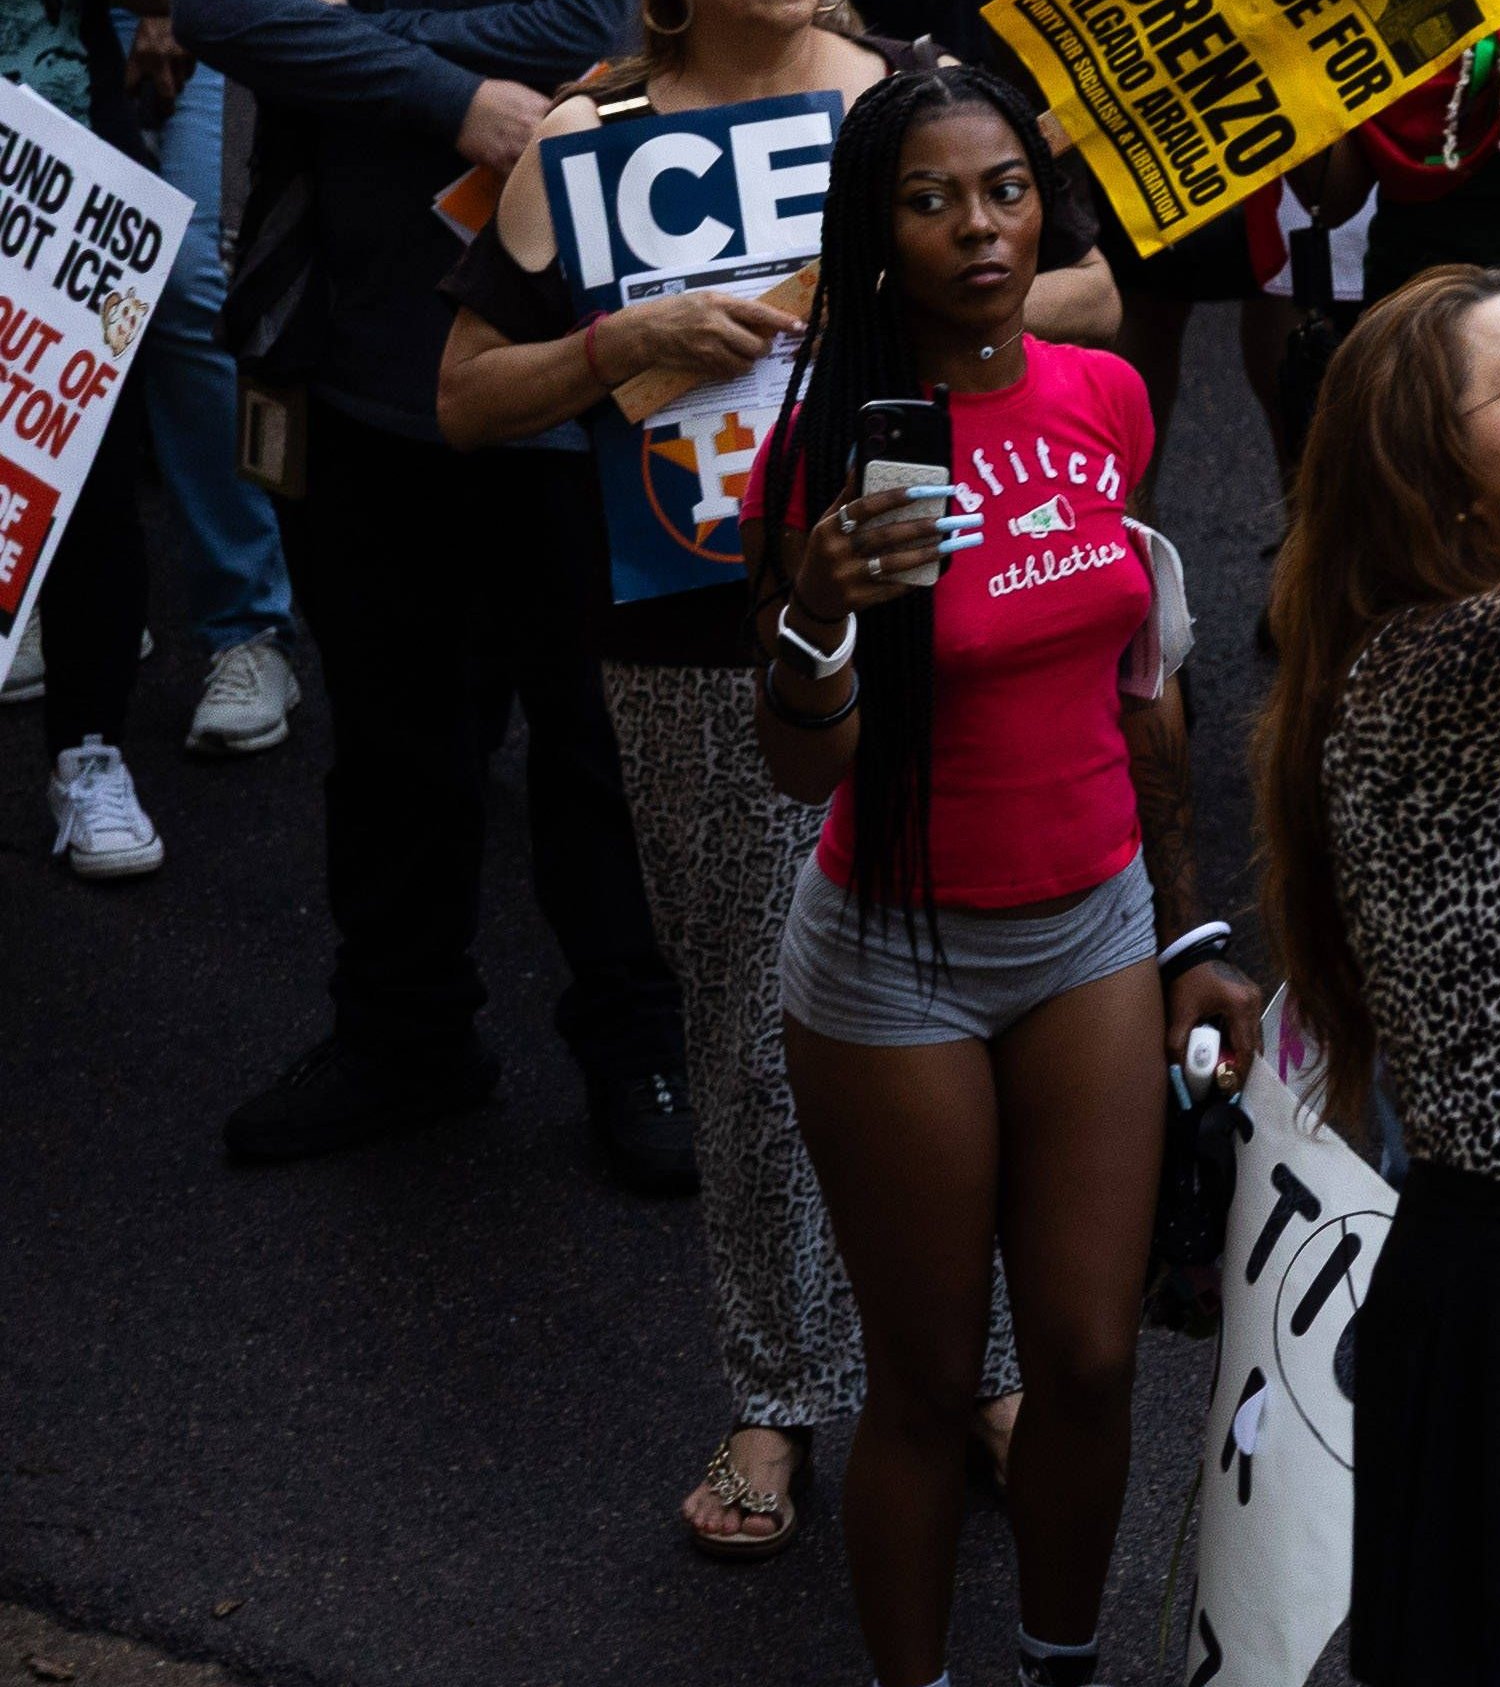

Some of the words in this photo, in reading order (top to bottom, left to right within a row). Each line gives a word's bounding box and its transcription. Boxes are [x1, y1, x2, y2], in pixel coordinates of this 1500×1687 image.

[1307, 18, 1394, 112] FOR
[1053, 26, 1083, 62] FOR
[1072, 54, 1123, 135] SOCIALISM
[1117, 129, 1134, 148] &
[1126, 141, 1183, 226] LIBERATION
[1132, 86, 1229, 208] ARAUJO
[75, 183, 164, 276] HISD
[560, 111, 834, 290] ICE
[52, 238, 123, 317] ICE
[58, 348, 121, 411] OF
[987, 541, 1127, 599] athletics
